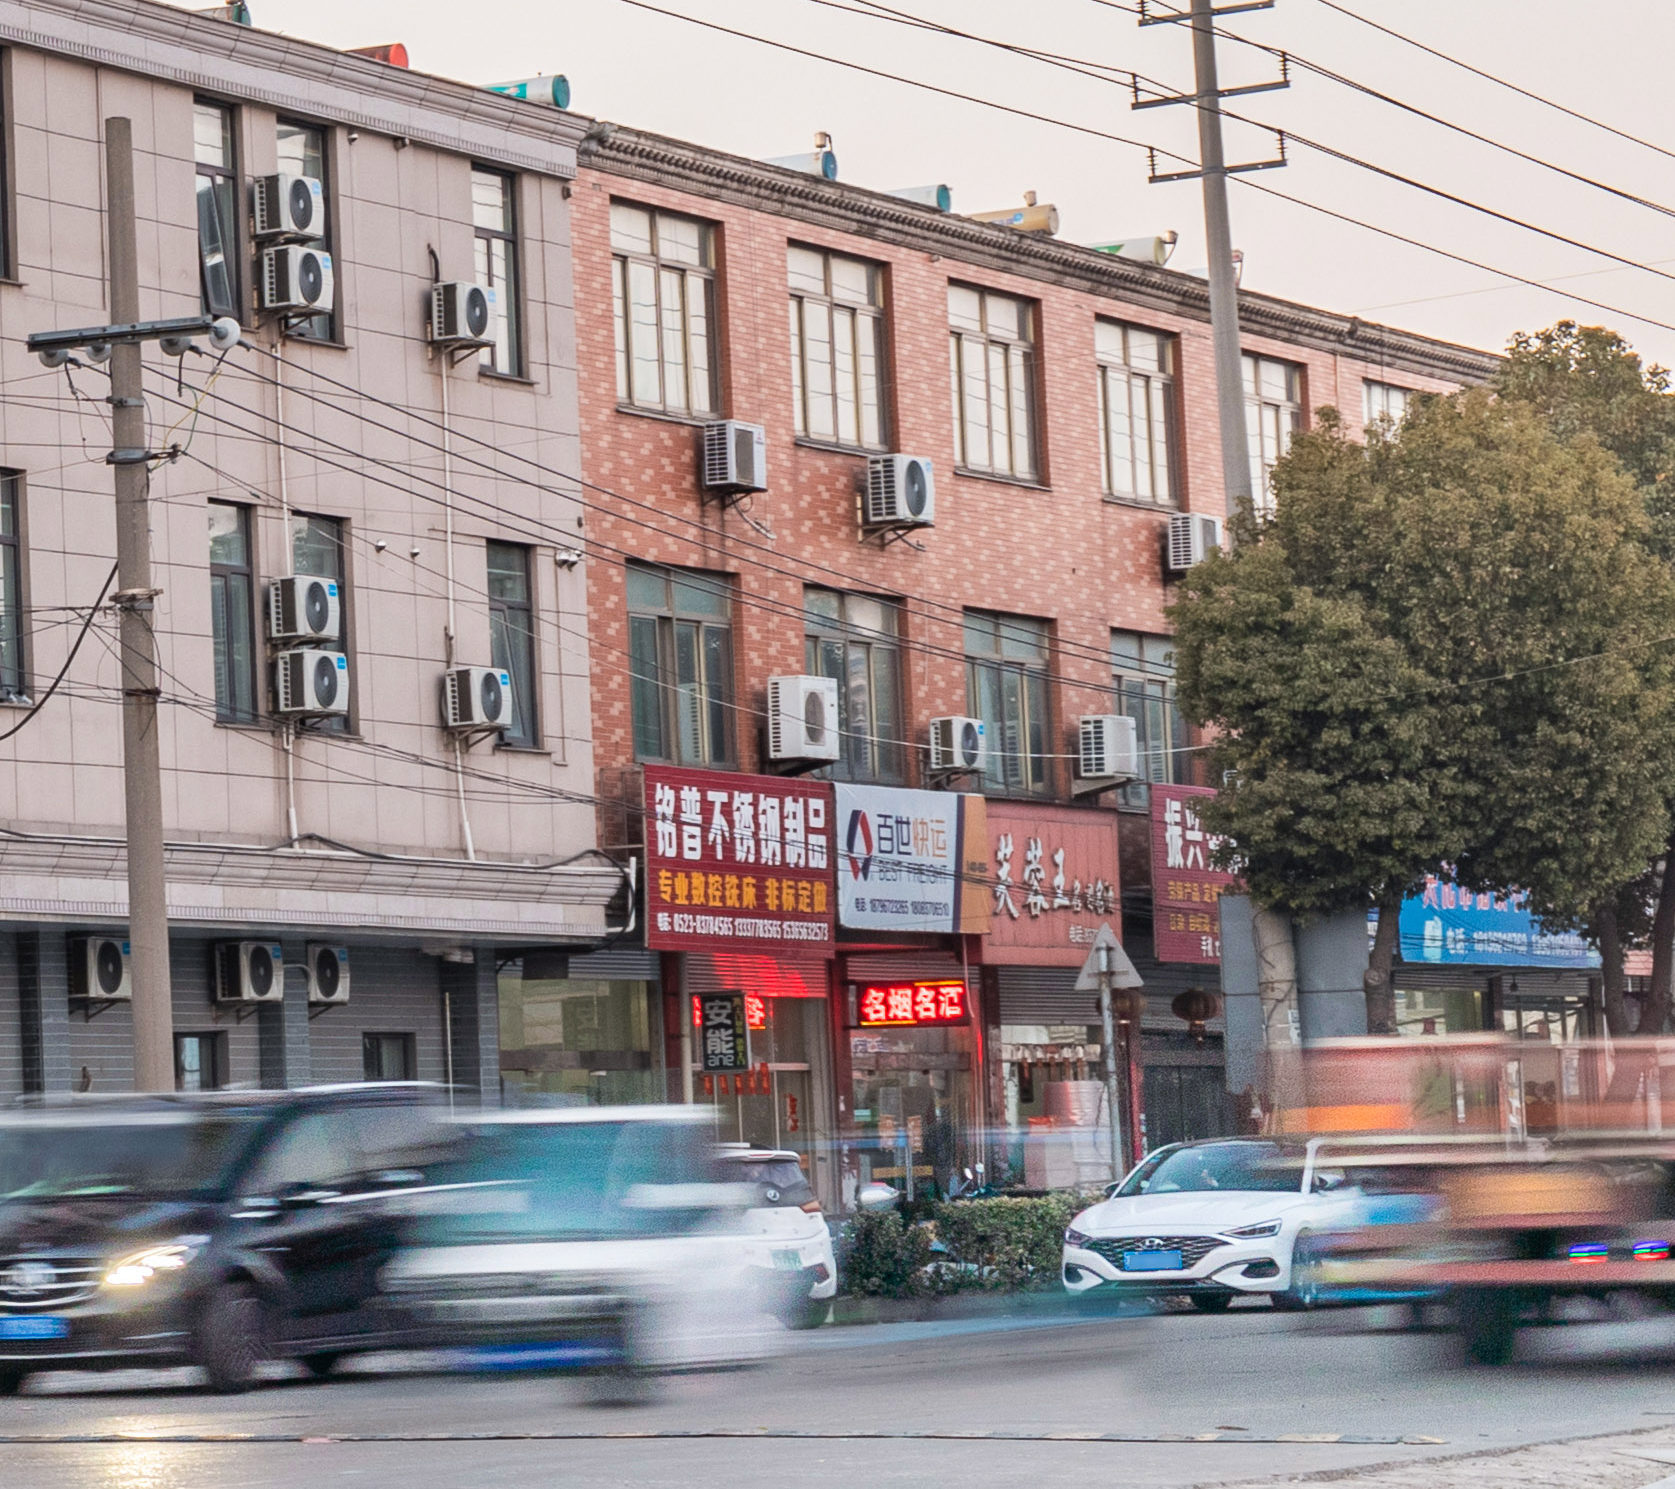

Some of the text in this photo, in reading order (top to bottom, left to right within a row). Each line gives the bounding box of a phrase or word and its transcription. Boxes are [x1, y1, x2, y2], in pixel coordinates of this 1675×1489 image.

[877, 813, 948, 858] 百世快运
[704, 998, 735, 1054] 安能
[707, 1054, 735, 1067] ane
